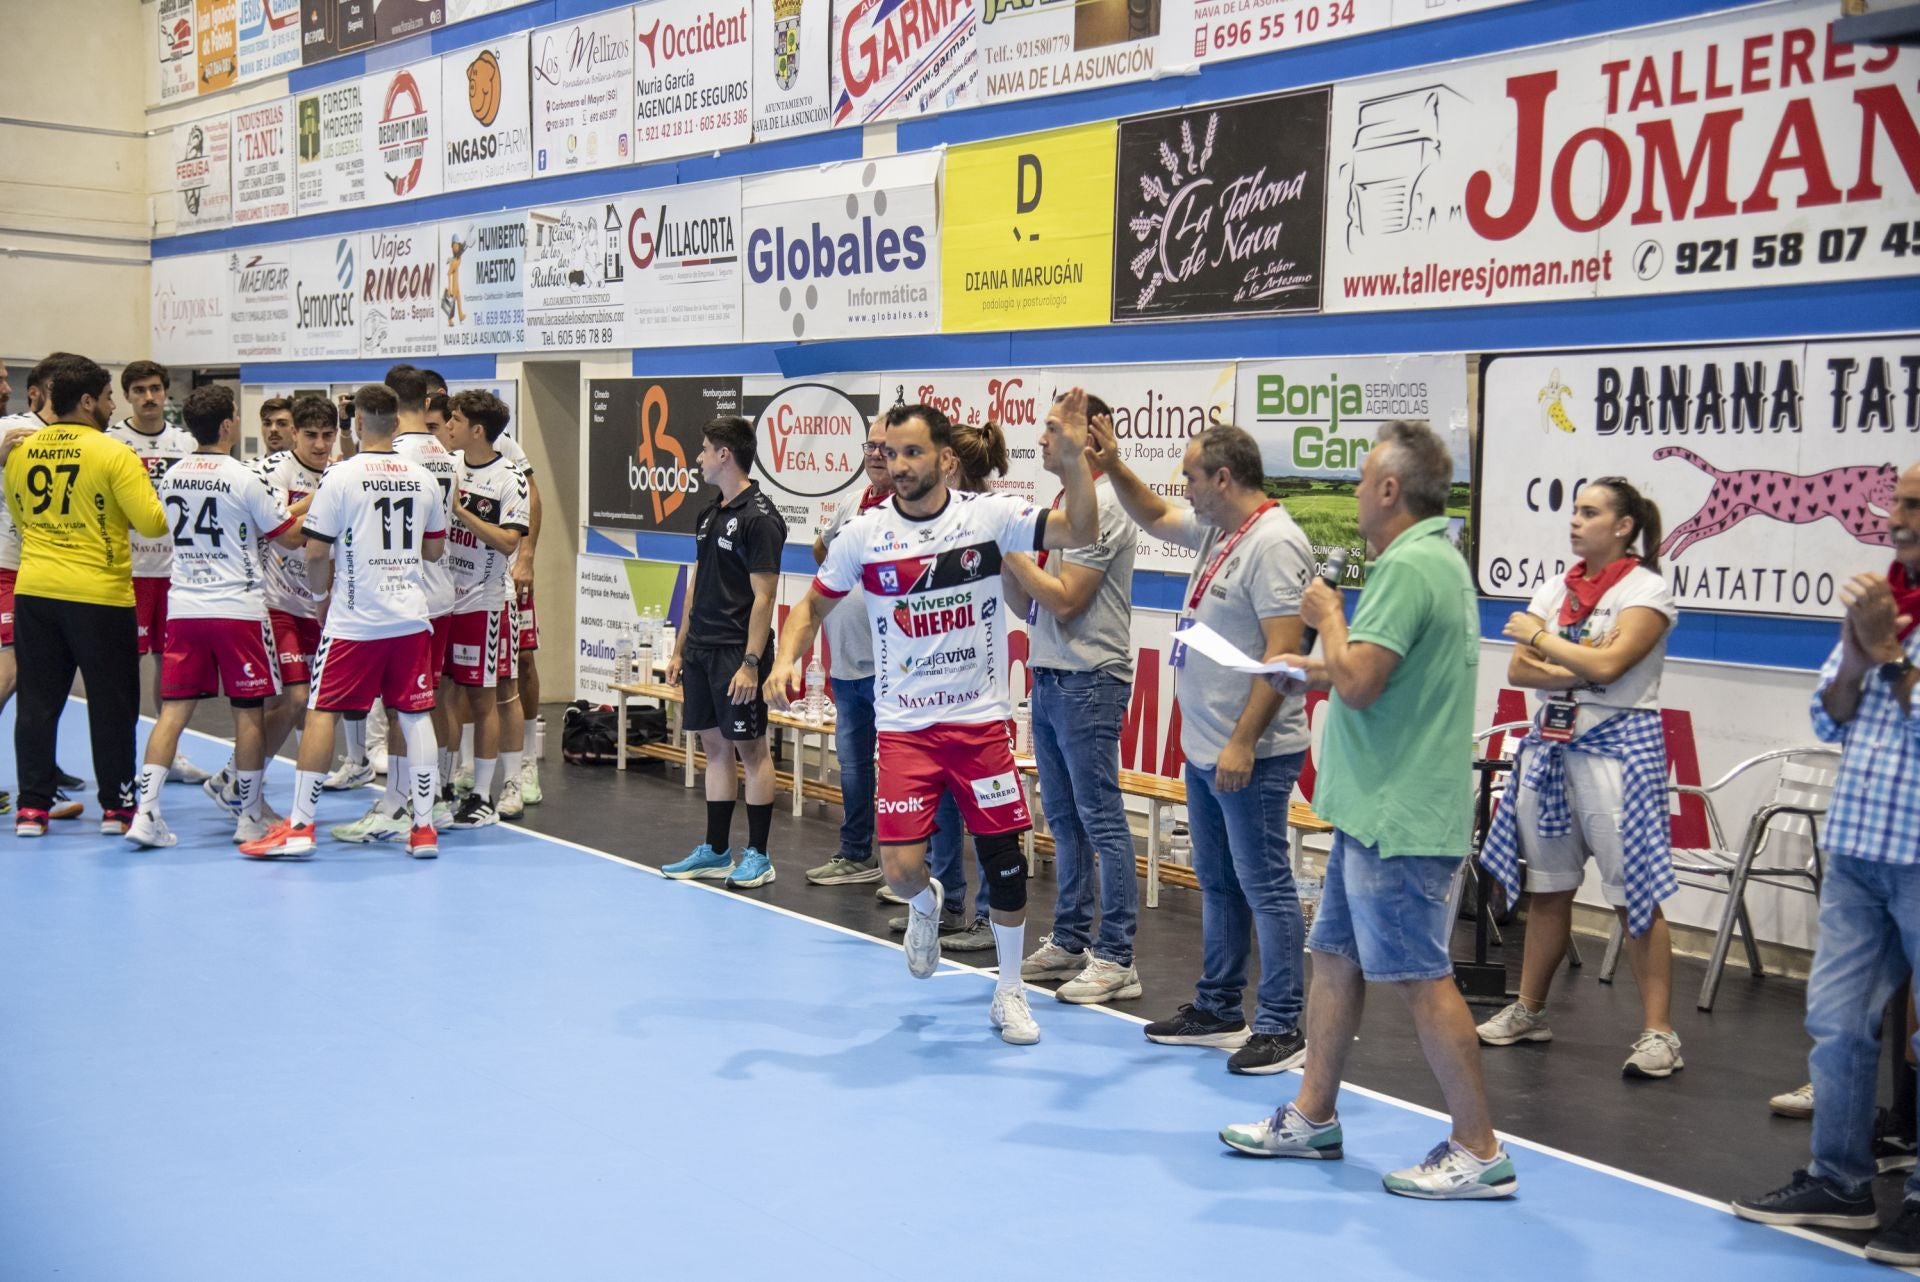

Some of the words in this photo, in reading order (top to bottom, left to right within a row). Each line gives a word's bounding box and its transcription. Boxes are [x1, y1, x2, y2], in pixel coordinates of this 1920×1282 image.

[1194, 5, 1220, 20] NAVA
[1224, 2, 1236, 15] DE
[662, 7, 747, 60] Occident
[1214, 20, 1251, 49] 696
[1260, 13, 1285, 41] 55
[1294, 6, 1319, 34] 10
[1327, 0, 1355, 28] 34
[567, 26, 629, 73] Mellizos
[1016, 34, 1070, 60] 921580779
[637, 79, 662, 97] Nuria
[664, 68, 694, 92] García
[987, 72, 1025, 97] NAVA
[1028, 68, 1048, 89] DE
[1053, 63, 1072, 86] LA
[1074, 44, 1155, 83] ASUNCIÓN
[322, 86, 363, 114] FORESTAL
[638, 95, 682, 120] AGENCIA
[684, 92, 698, 111] DE
[700, 80, 748, 107] SEGUROS
[765, 96, 813, 114] AYUNTAMIENTO
[237, 105, 283, 132] INDUSTRIAS
[323, 112, 363, 140] MADERERA
[637, 128, 643, 143] T.
[645, 125, 659, 140] 921
[661, 123, 671, 138] 42
[673, 121, 682, 136] 18
[684, 119, 693, 134] 11
[700, 114, 714, 131] 605
[716, 112, 731, 128] 245
[733, 109, 748, 126] 386
[770, 115, 779, 130] DE
[780, 113, 791, 129] LA
[791, 104, 829, 126] ASUNCIÓN
[176, 160, 210, 180] FEGUSA
[1175, 195, 1213, 241] La
[1220, 166, 1307, 227] Tahona
[372, 234, 412, 265] Viajes
[478, 222, 525, 252] HUMBERTO
[748, 216, 927, 284] Globales
[1675, 238, 1738, 275] 921
[1752, 232, 1804, 269] 58
[1818, 226, 1868, 264] 07
[1881, 221, 1920, 257] 4
[1178, 234, 1208, 282] de
[1211, 222, 1283, 268] Nava
[239, 268, 289, 293] MAEMBAR
[476, 258, 516, 284] MAESTRO
[531, 267, 567, 288] Rubios
[965, 271, 1008, 291] DIANA
[1012, 258, 1083, 289] MARUGÁN
[1264, 259, 1297, 277] Sabor
[1343, 250, 1613, 298] www.talleresjoman.net
[363, 262, 435, 302] RINCON
[1261, 274, 1313, 292] Artesano
[297, 280, 354, 329] Semorsec
[848, 284, 928, 307] Informática
[1016, 301, 1022, 311] y
[391, 306, 405, 320] Coca
[412, 305, 434, 322] Segovia
[848, 310, 929, 325] www.globales.es
[444, 333, 460, 346] NAVA
[462, 332, 470, 345] DE
[471, 331, 478, 344] LA
[516, 329, 525, 343] SG
[541, 331, 556, 345] Tel.
[558, 330, 573, 345] 605
[575, 329, 586, 344] 96
[589, 328, 599, 344] 78
[602, 328, 613, 343] 89
[1257, 373, 1363, 434] Borja
[1365, 383, 1428, 398] SERVICIOS
[1595, 359, 1804, 436] BANANA
[716, 401, 737, 410] Sandwich
[967, 406, 981, 425] de
[1366, 400, 1429, 415] AGRICOLAS
[777, 403, 852, 437] CARRION
[27, 449, 81, 459] MARTINS
[825, 451, 853, 473] S.A.
[1010, 447, 1036, 460] RÚSTICO
[1124, 446, 1132, 461] y
[1135, 443, 1164, 461] Ropa
[1167, 443, 1182, 458] de
[172, 478, 231, 494] MARUGÁN
[362, 480, 422, 492] PUGLIESE
[628, 455, 699, 494] bocados
[27, 464, 81, 515] 97
[165, 495, 224, 548] 24
[373, 497, 414, 550] 11
[873, 540, 909, 553] eufón
[368, 558, 397, 566] CASTILLA
[920, 556, 938, 590] 7
[911, 592, 973, 613] VIVEROS
[581, 616, 603, 628] ABONOS
[913, 604, 976, 638] HEROL
[580, 639, 616, 661] Paulino
[985, 622, 997, 686] POLISAC
[979, 787, 1017, 801] HERRERO
[1000, 865, 1020, 877] SELECT
